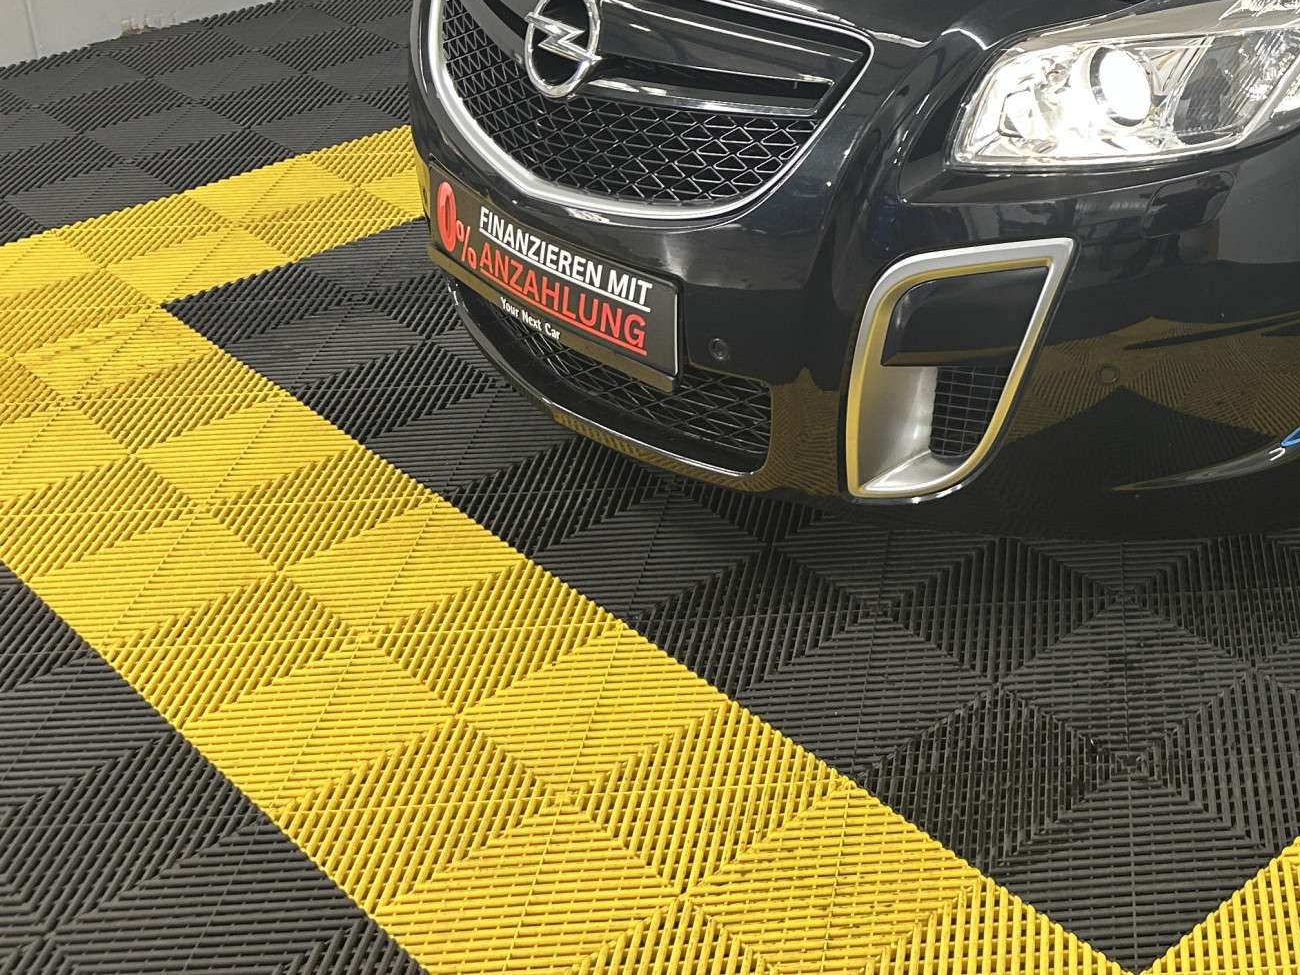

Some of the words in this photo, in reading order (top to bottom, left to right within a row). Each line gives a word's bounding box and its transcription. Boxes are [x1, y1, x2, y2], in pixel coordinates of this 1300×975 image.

[437, 181, 477, 270] 0%
[480, 206, 603, 288] FINANZIEREN
[608, 269, 652, 306] MIT
[480, 241, 647, 349] ANZAHLUNG
[500, 296, 520, 318] Your
[521, 309, 542, 331] Next
[544, 322, 560, 340] Car
